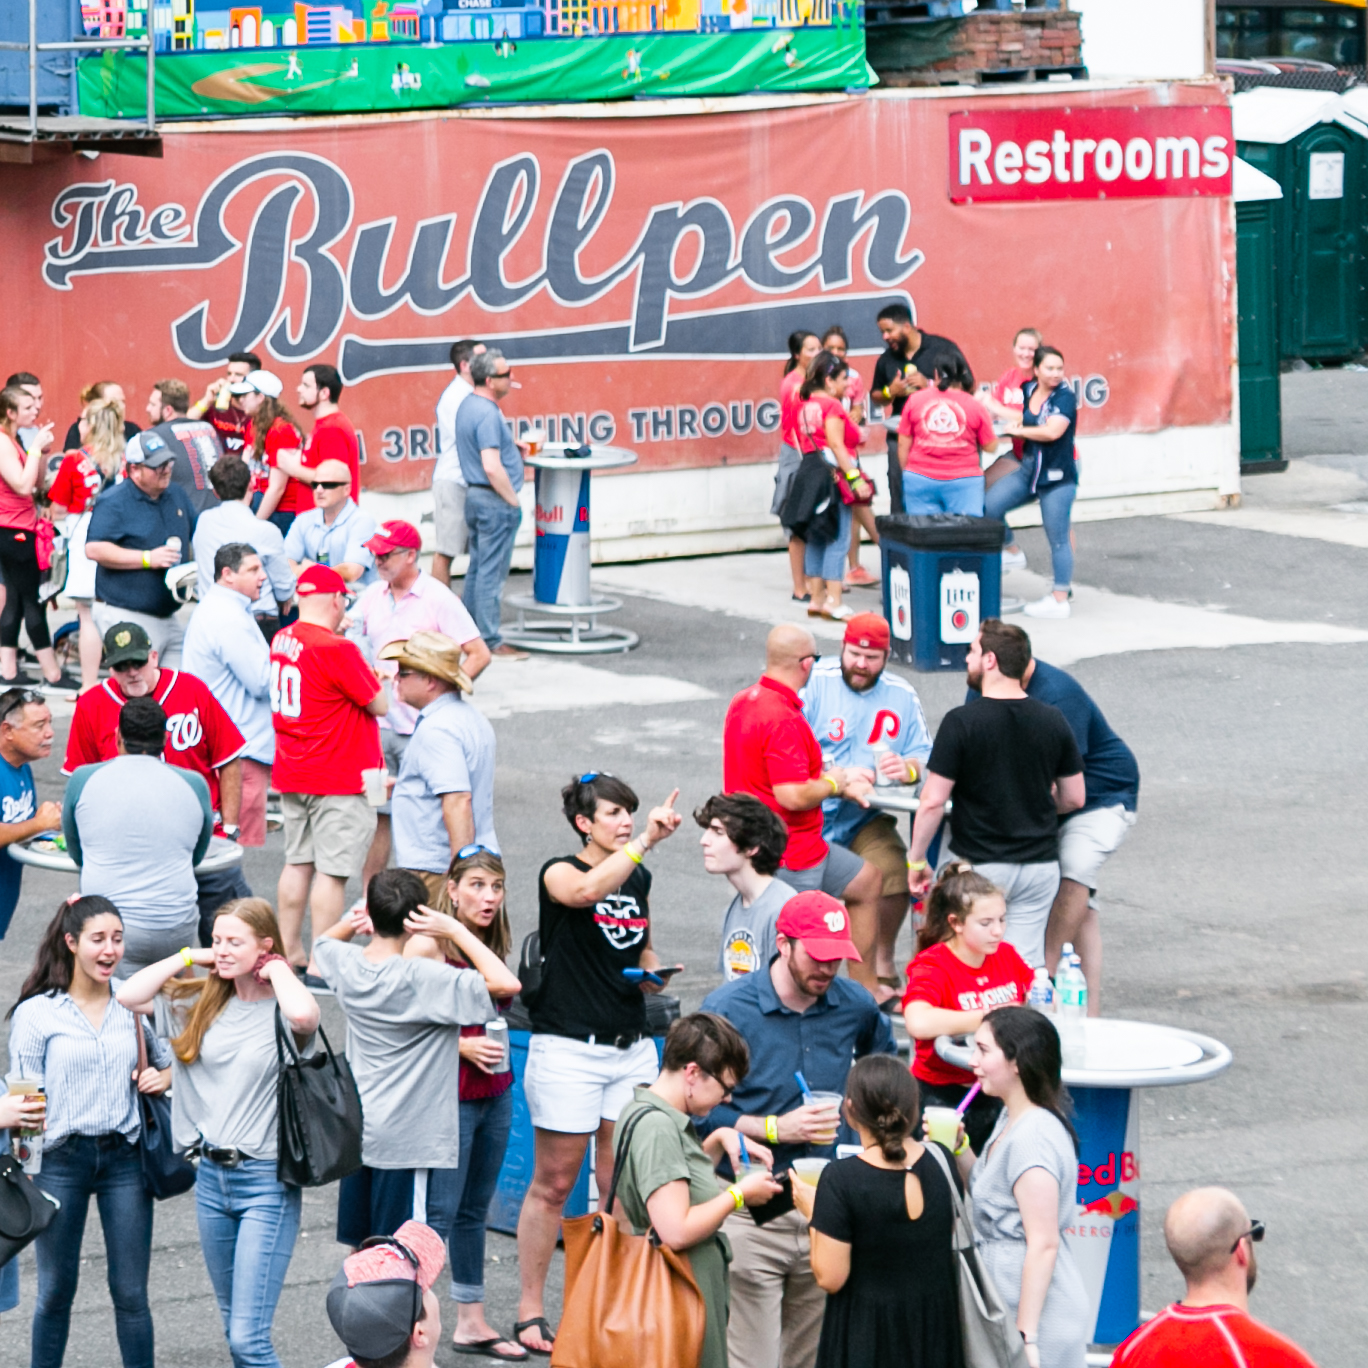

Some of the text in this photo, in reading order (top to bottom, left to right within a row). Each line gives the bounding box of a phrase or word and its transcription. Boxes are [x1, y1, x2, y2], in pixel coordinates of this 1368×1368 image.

[957, 126, 1231, 188] Restrooms
[46, 148, 926, 369] The Bullpen
[629, 397, 782, 444] THROUG
[946, 588, 976, 607] Lite
[827, 717, 846, 743] 3
[867, 708, 901, 746] P
[957, 992, 983, 1013] ST.
